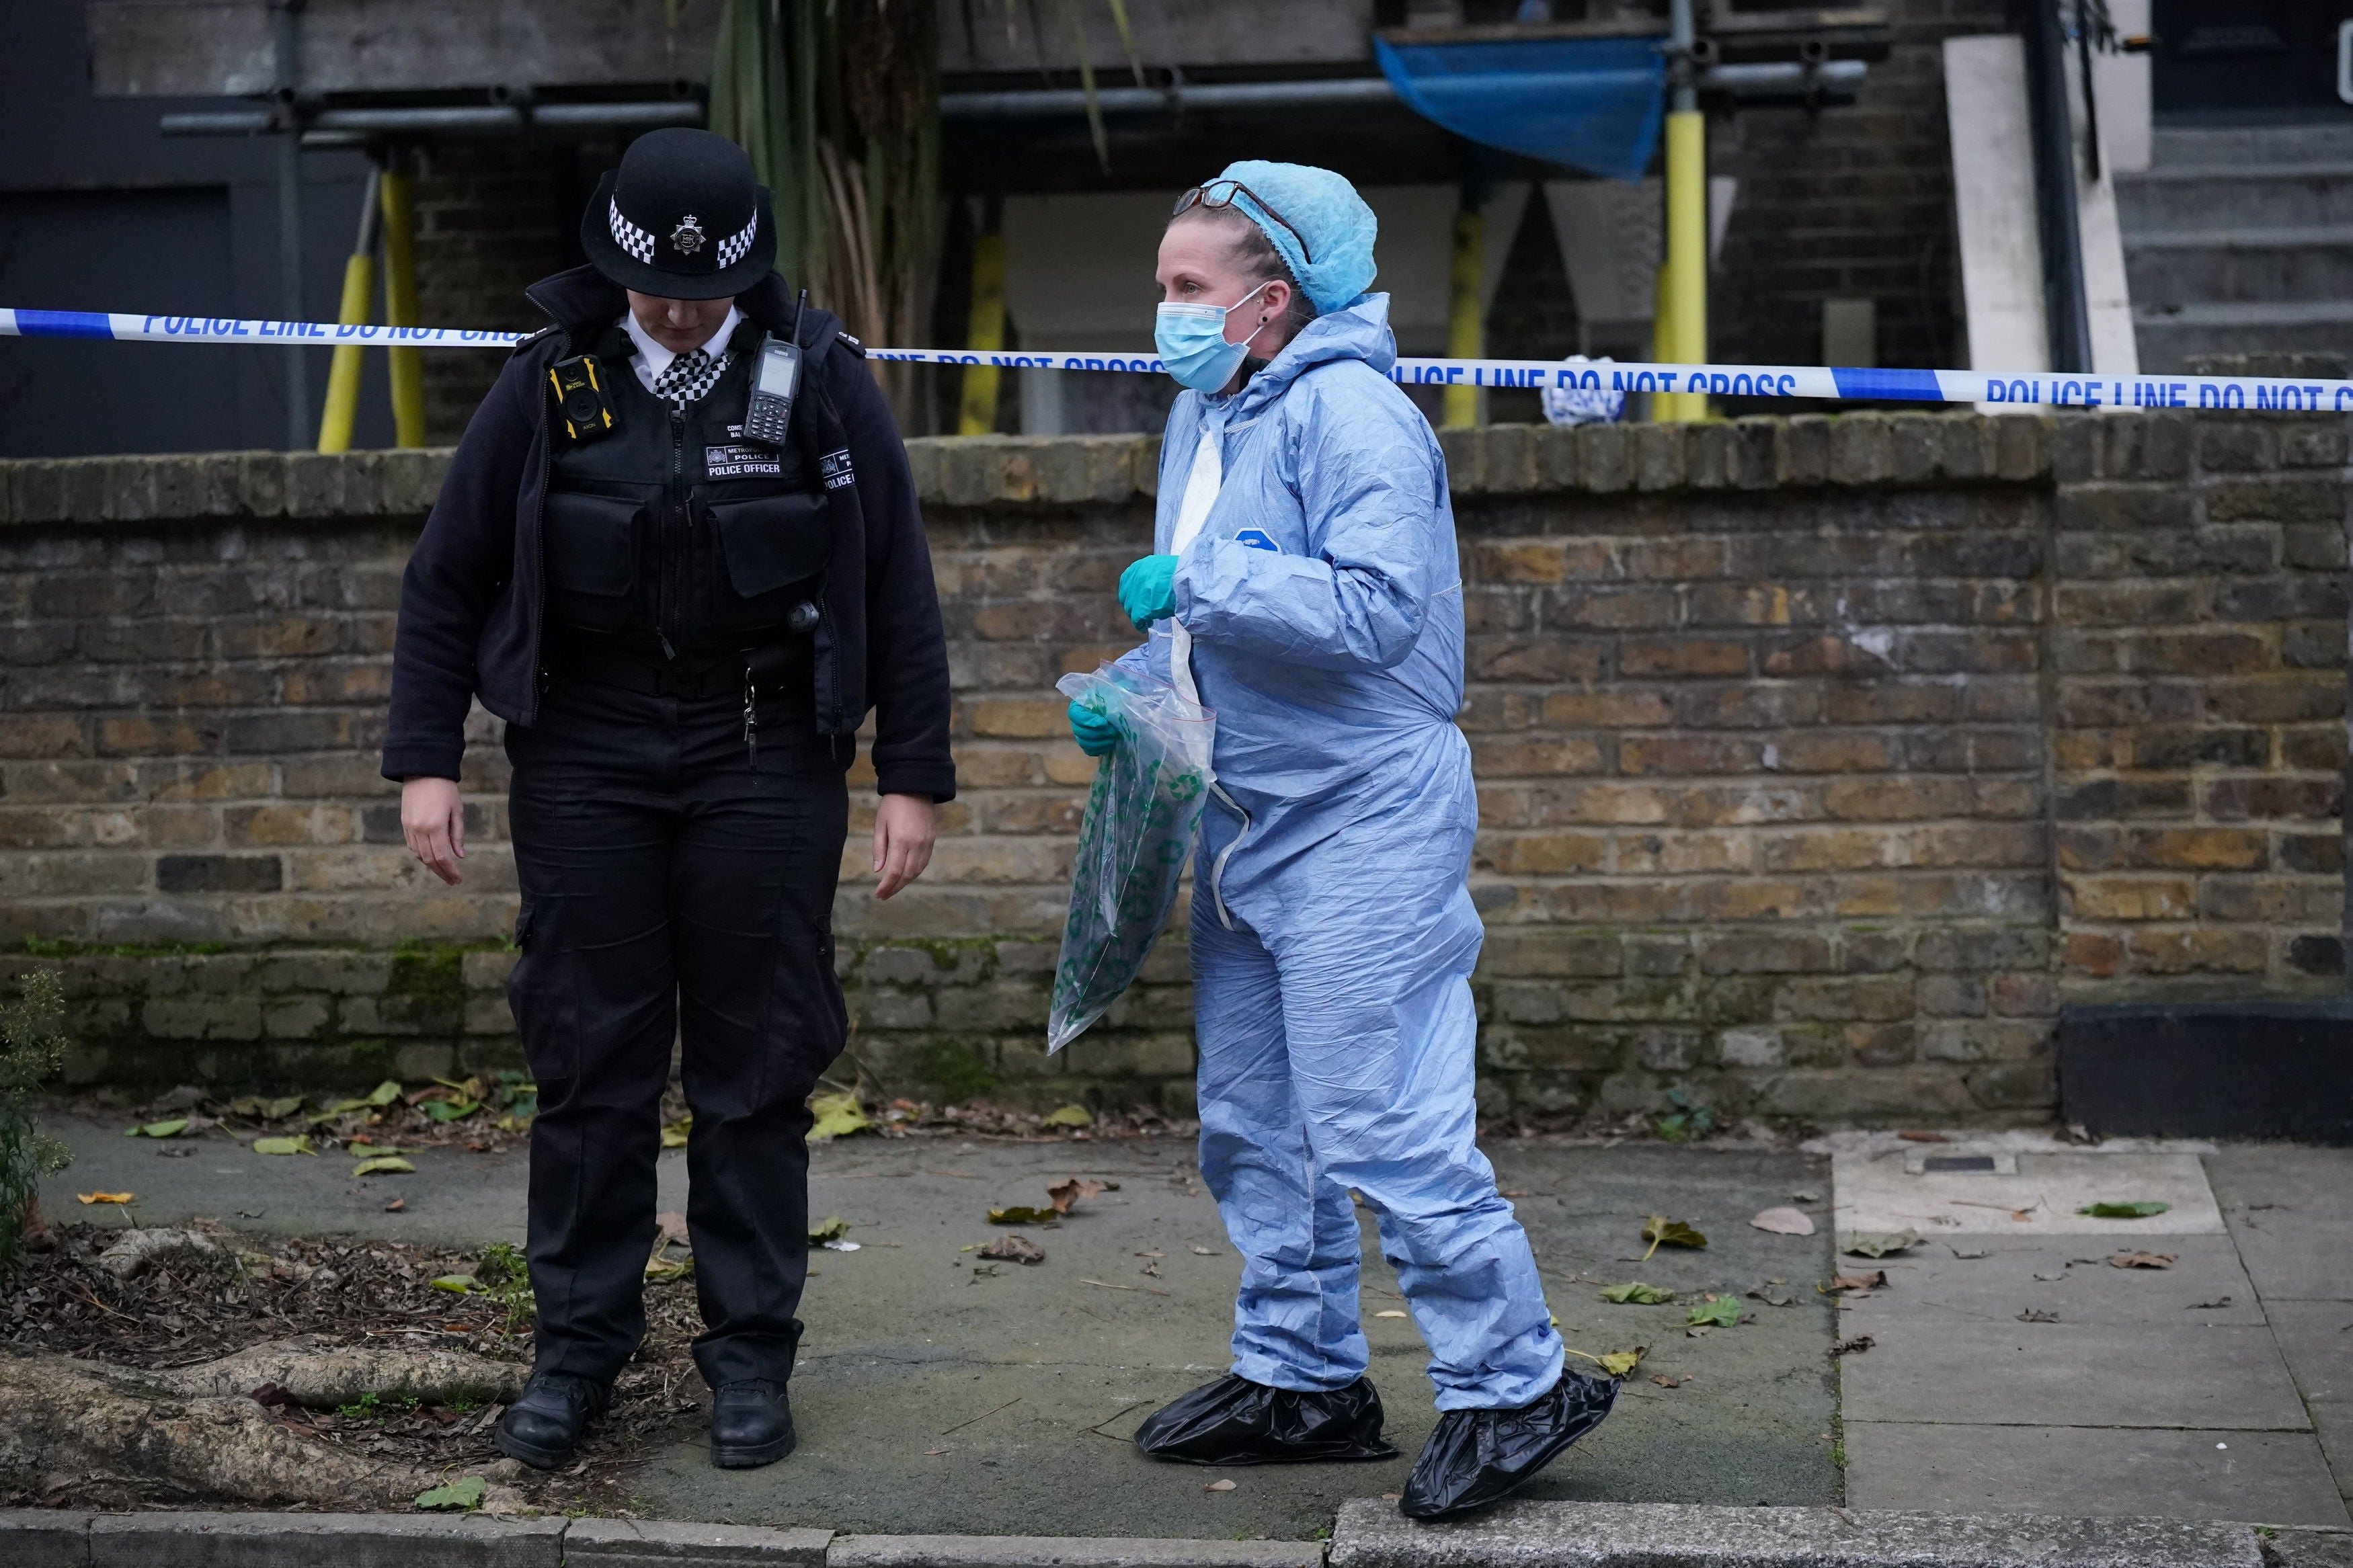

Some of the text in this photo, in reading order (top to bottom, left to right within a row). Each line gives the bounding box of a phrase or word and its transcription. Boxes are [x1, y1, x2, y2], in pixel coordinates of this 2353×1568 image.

[1987, 380, 2102, 405] POLICE
[2115, 382, 2186, 407] LINE
[2200, 384, 2244, 409] DO
[2257, 385, 2323, 411] NOT
[709, 464, 780, 476] POLICE OFFICER
